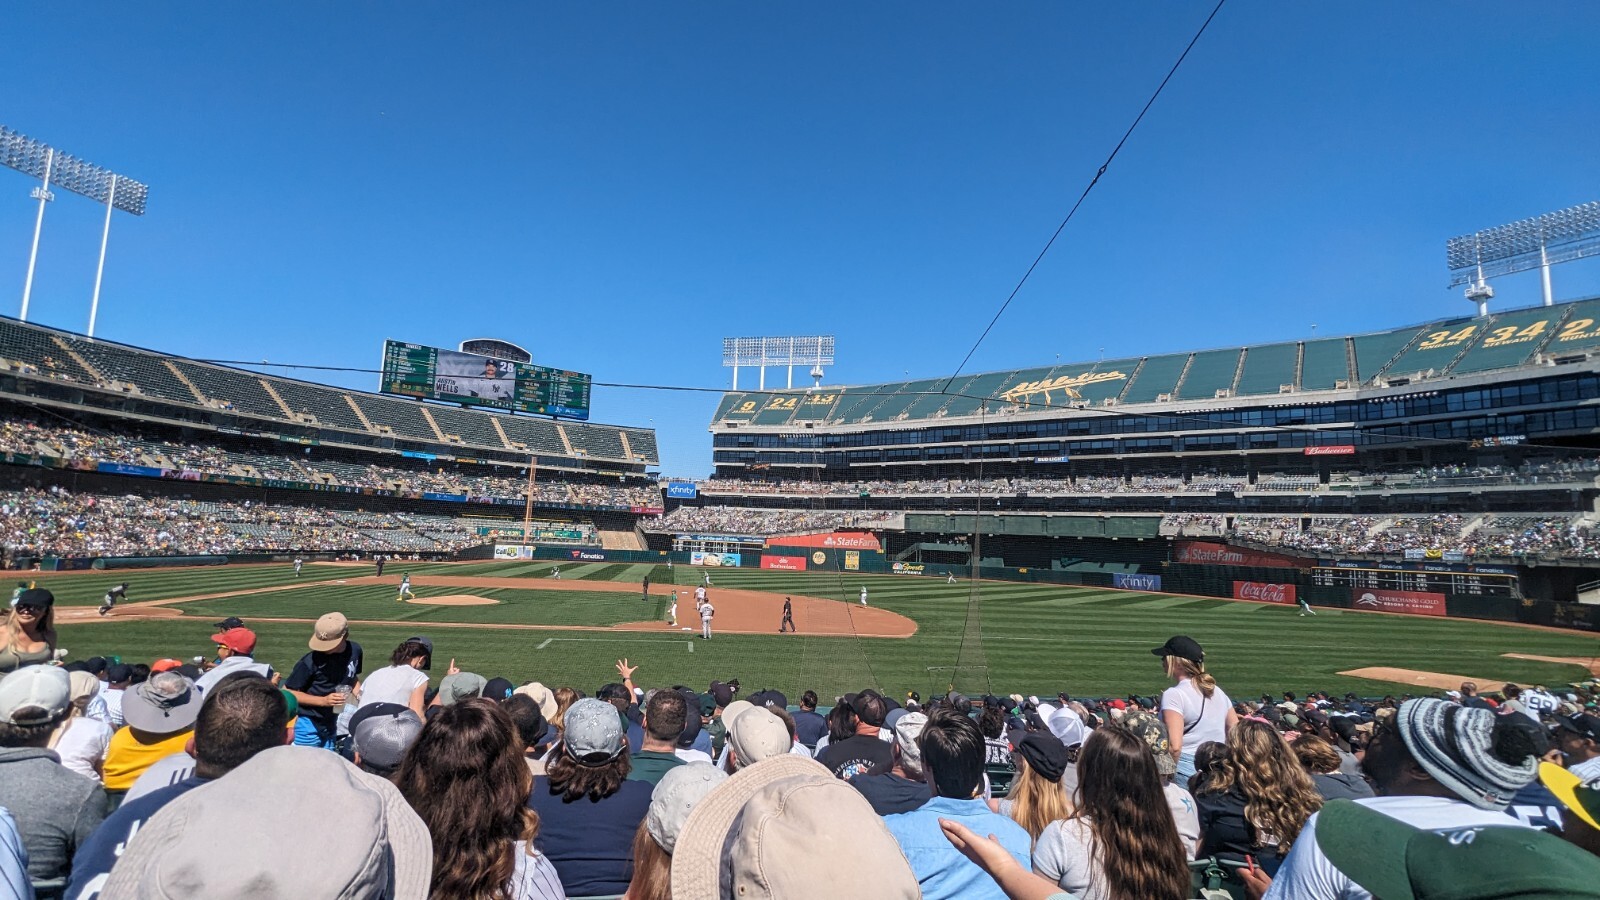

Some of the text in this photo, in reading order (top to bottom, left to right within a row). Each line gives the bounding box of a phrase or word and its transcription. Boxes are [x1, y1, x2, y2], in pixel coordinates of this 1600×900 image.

[1485, 320, 1548, 343] 34
[1559, 319, 1600, 339] 2
[1419, 325, 1477, 346] 34
[1482, 336, 1535, 349] STEWART
[500, 361, 514, 373] 28
[437, 377, 456, 386] AUSTIN
[435, 382, 459, 393] WELLS
[740, 401, 756, 411] 9
[769, 397, 798, 408] 24
[1308, 446, 1353, 455] Budweiser
[670, 486, 694, 496] xfinity
[837, 536, 880, 547] State Farm
[580, 552, 605, 560] Fanatics
[1192, 548, 1243, 563] State Farm
[902, 562, 925, 571] Sports
[1120, 574, 1154, 590] xfinity
